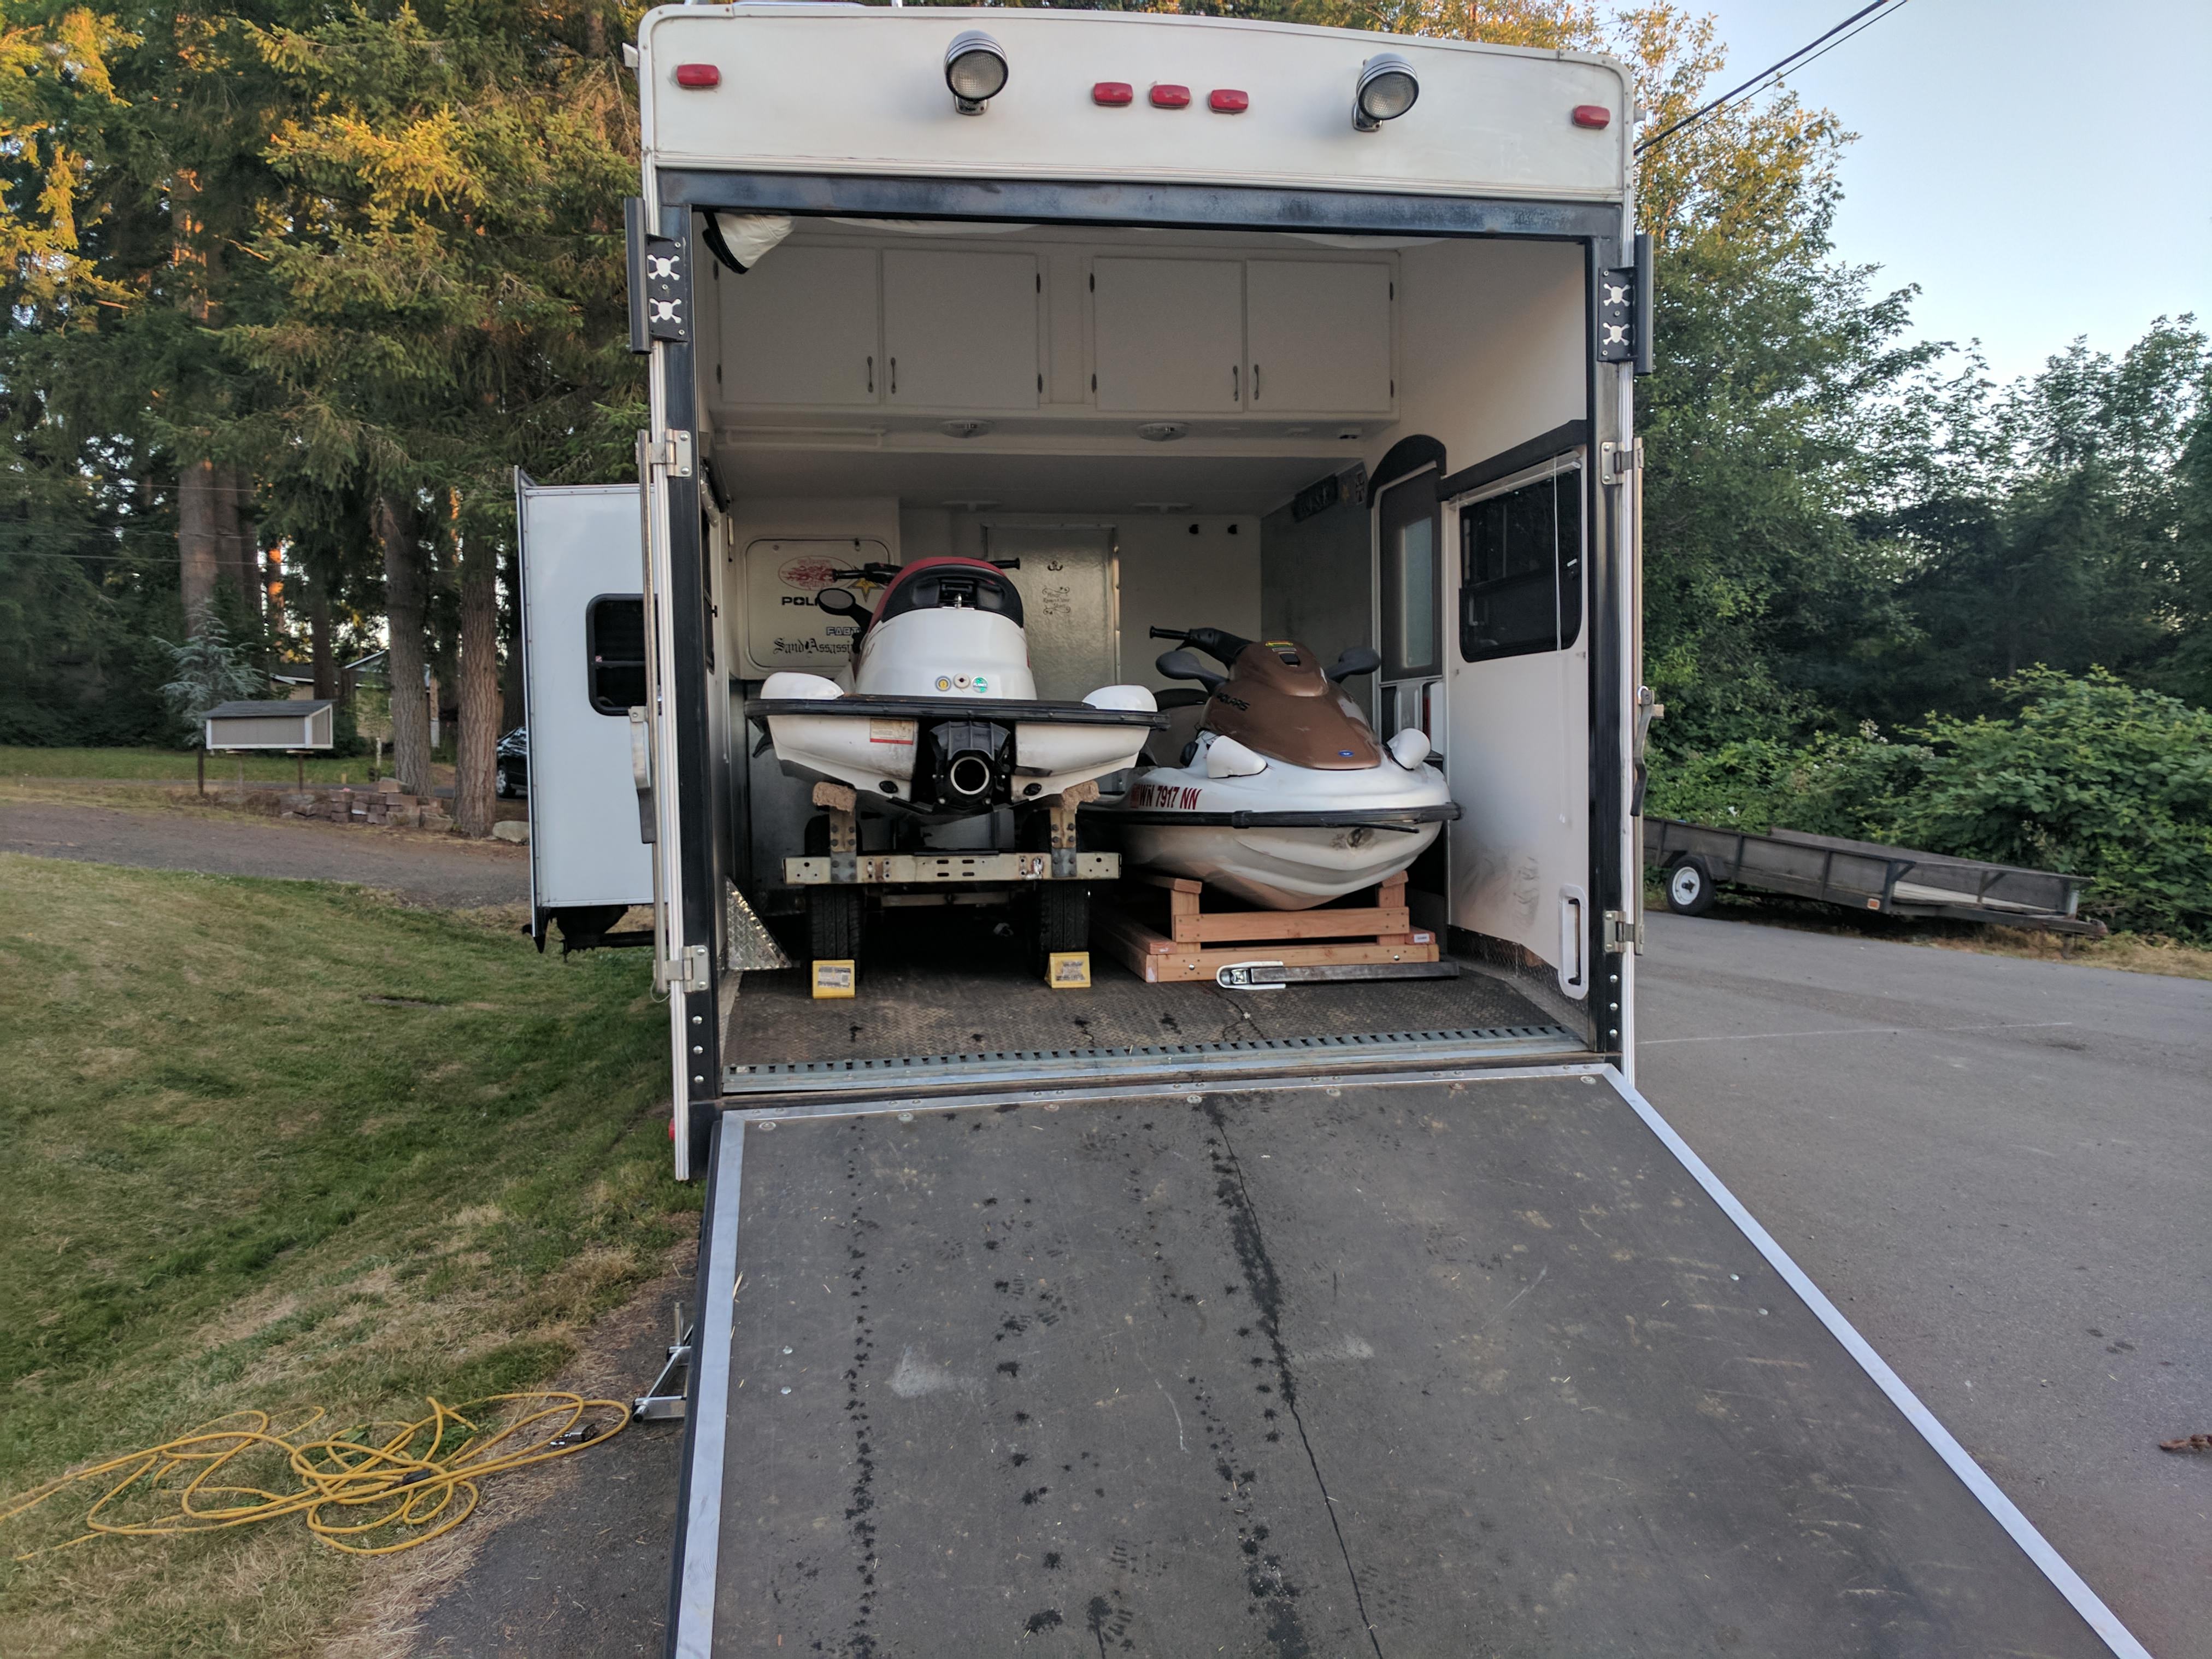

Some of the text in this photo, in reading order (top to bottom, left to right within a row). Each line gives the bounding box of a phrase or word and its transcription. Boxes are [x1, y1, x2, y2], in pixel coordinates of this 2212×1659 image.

[1139, 784, 1202, 810] WN 7917 NN
